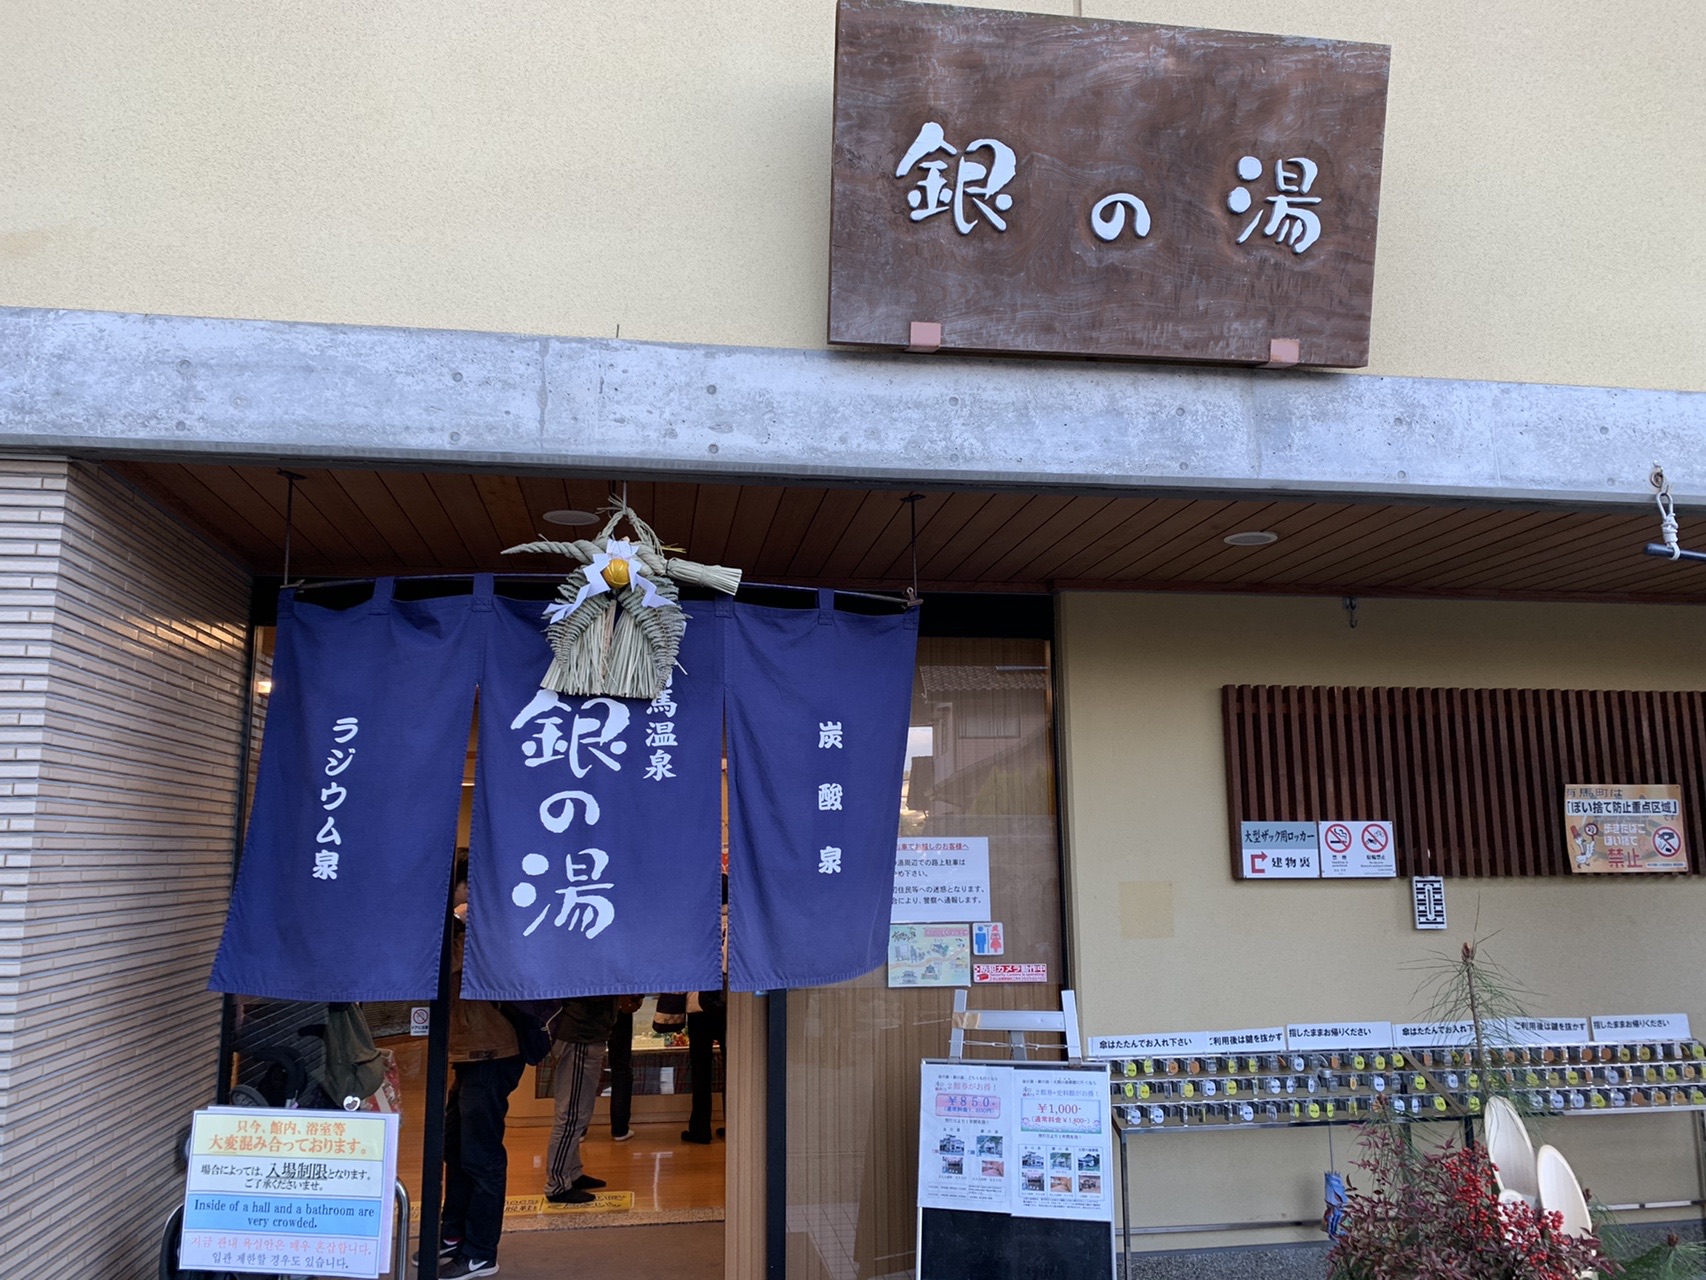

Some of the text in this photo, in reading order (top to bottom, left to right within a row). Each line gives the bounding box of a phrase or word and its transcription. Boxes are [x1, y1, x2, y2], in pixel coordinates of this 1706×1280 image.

[896, 122, 1322, 254] 銀の湯
[643, 674, 678, 782] 馬温泉
[312, 717, 358, 880] ラジウム泉
[818, 721, 843, 874] 炭酸泉
[511, 689, 630, 939] 銀の湯
[1245, 829, 1315, 843] 大型ザック用ロッカー
[1608, 848, 1643, 868] 禁止
[1099, 1038, 1193, 1049] 傘はたたんでお入れ下さい
[237, 1120, 347, 1137] 只今、館内、浴室等
[209, 1134, 367, 1155] 大変混み合っております。
[201, 1162, 371, 1181] 場合によっては、入場制限となります。
[244, 1178, 324, 1191] ご了承くださいませ。
[194, 1199, 375, 1217] Inside of a hall and a bathroom are
[247, 1215, 318, 1229] very crowded.
[192, 1236, 213, 1248] 지금
[217, 1237, 238, 1249] 관내
[289, 1240, 311, 1252] 매우
[212, 1252, 349, 1269] 입관 제한할 경우도 있습니다.
